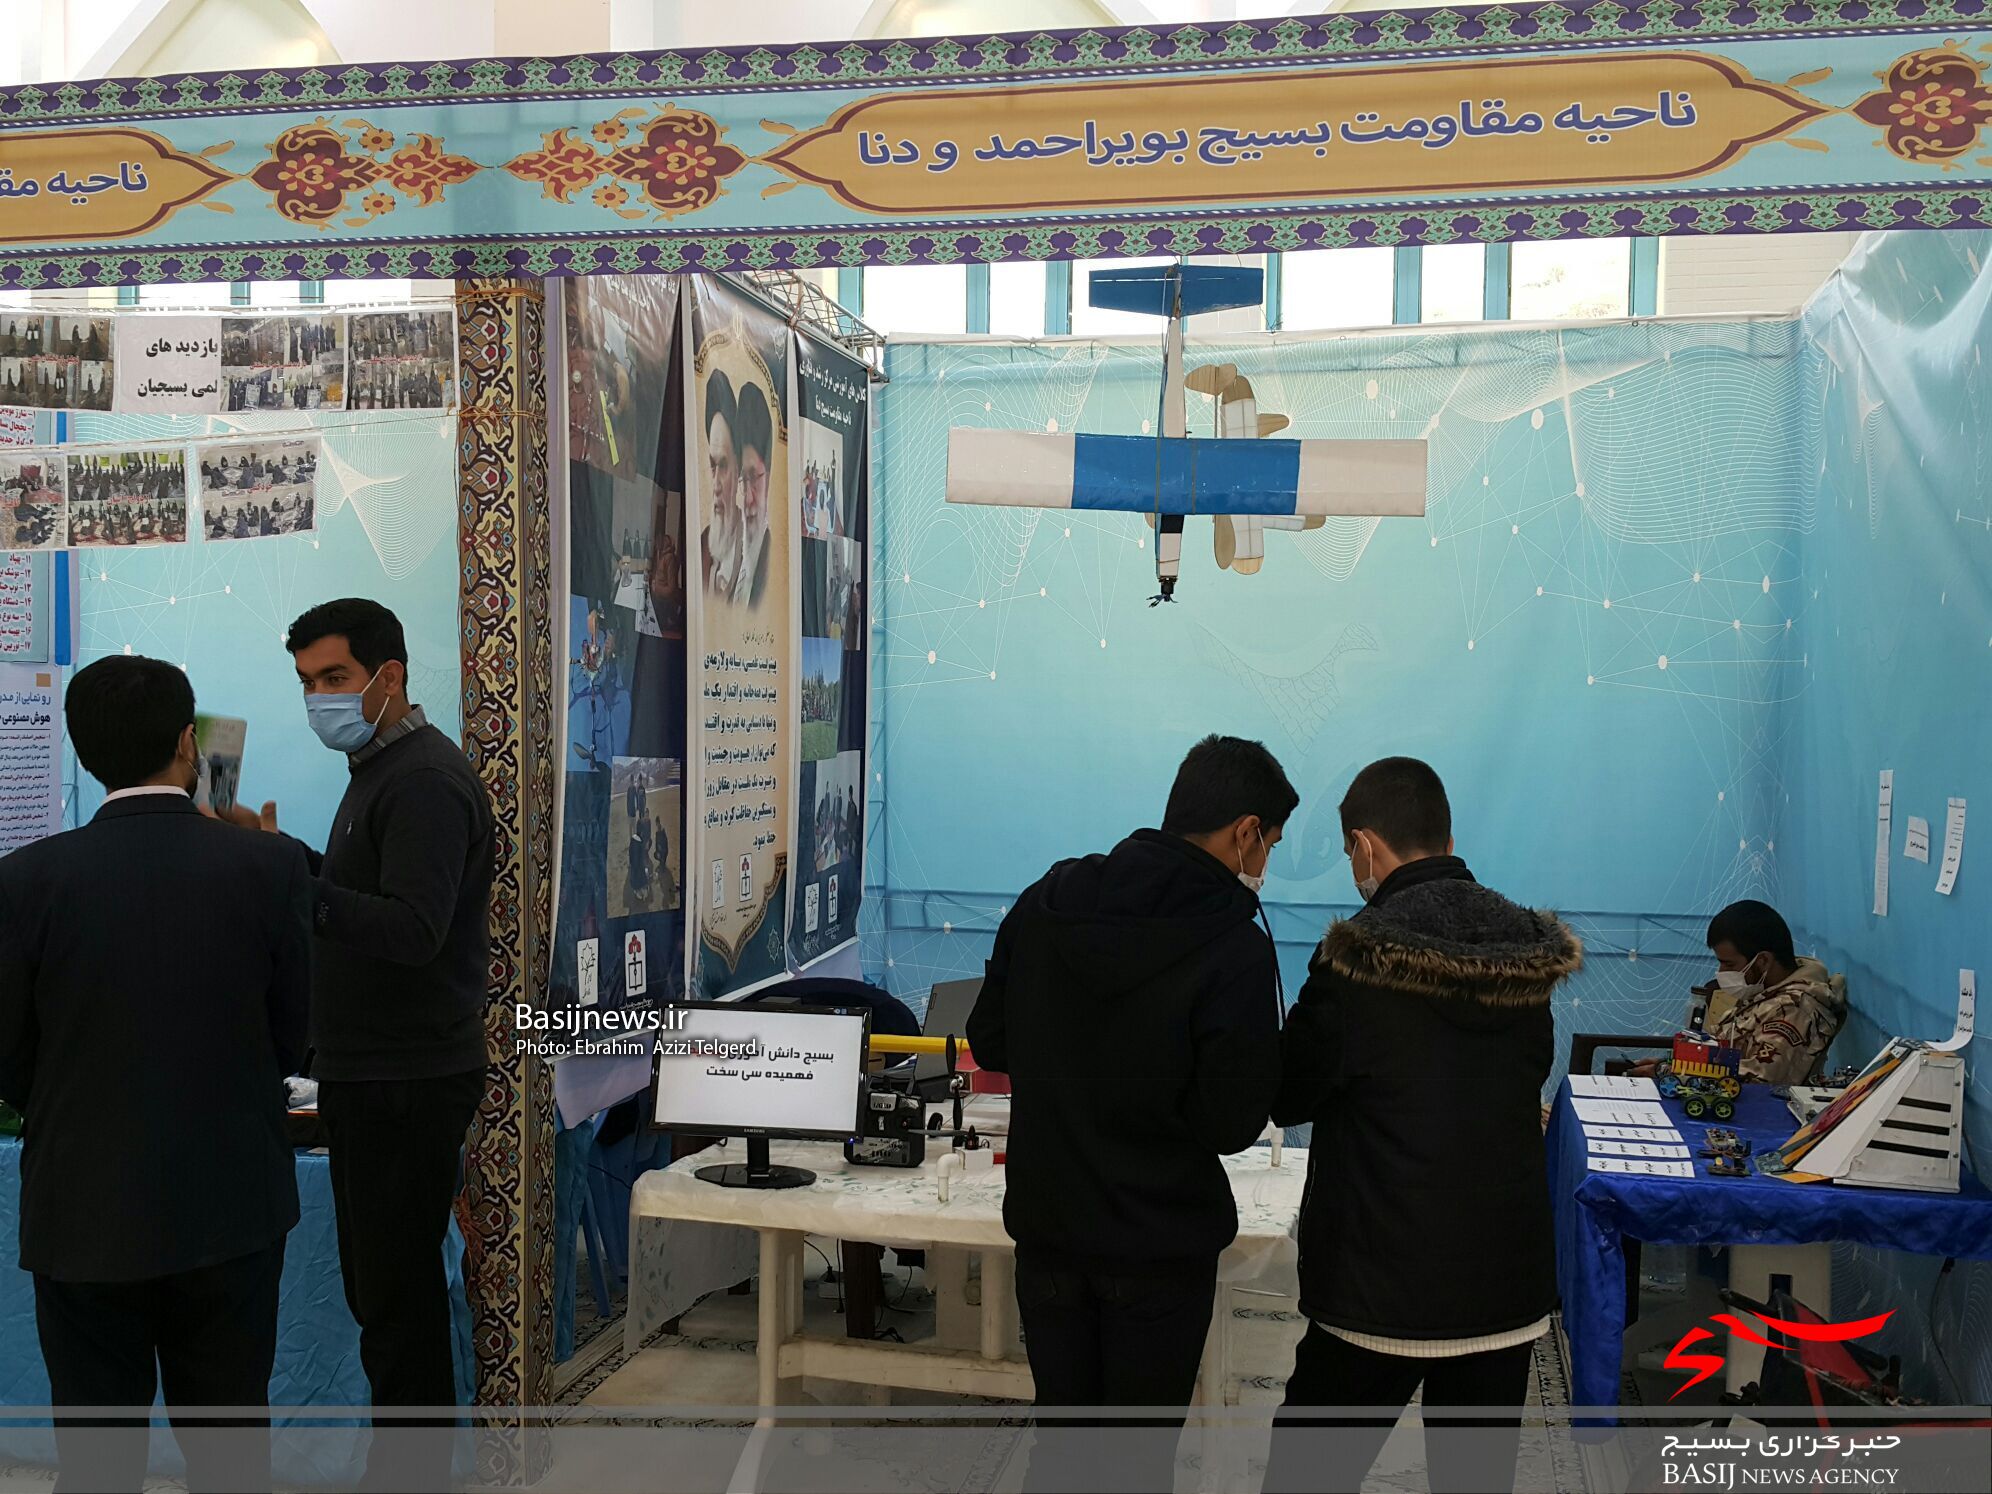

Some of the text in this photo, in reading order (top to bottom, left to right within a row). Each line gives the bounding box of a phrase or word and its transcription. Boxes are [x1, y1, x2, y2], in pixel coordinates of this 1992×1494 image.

[858, 90, 1698, 173] ناحیه مقاومت بسیج بویراحمد و دنا
[0, 161, 148, 205] ناحیه مق
[146, 337, 172, 358] های
[137, 378, 218, 398] لمی بسیجیان
[2, 711, 51, 726] هوش مصنوعی
[768, 1045, 800, 1062] دانش
[803, 1050, 834, 1065] بسیج
[706, 1065, 814, 1082] فهمیده سی سخت
